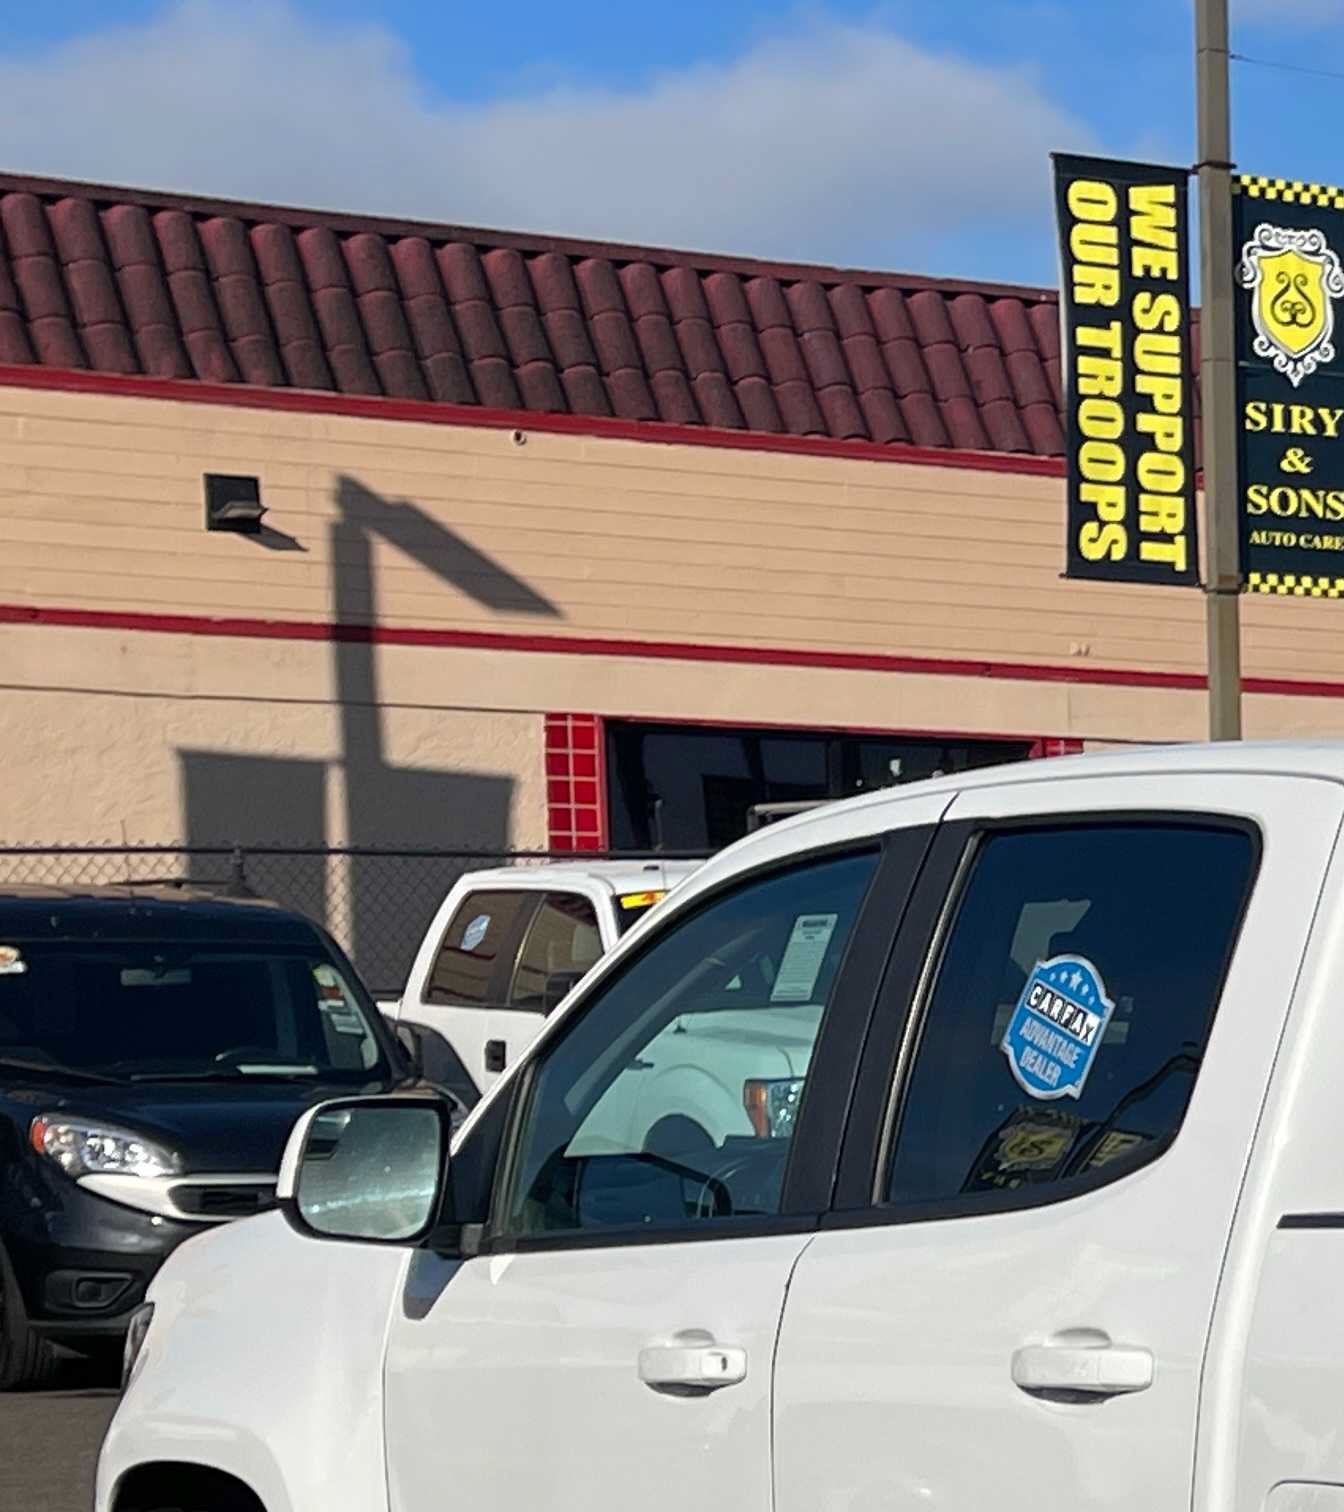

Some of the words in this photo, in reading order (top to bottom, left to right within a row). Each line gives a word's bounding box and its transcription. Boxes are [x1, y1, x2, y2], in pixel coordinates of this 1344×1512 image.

[1067, 179, 1119, 307] OUR
[1128, 184, 1178, 281] WE
[1075, 321, 1128, 562] TROOPS
[1131, 292, 1187, 571] SUPPORT
[1244, 402, 1344, 437] SIRY
[1280, 448, 1313, 474] &
[1250, 530, 1298, 549] AUTO
[1029, 985, 1096, 1043] CARFAX
[1019, 1017, 1081, 1069] ADVANTAGE
[1019, 1046, 1062, 1087] DEALER
